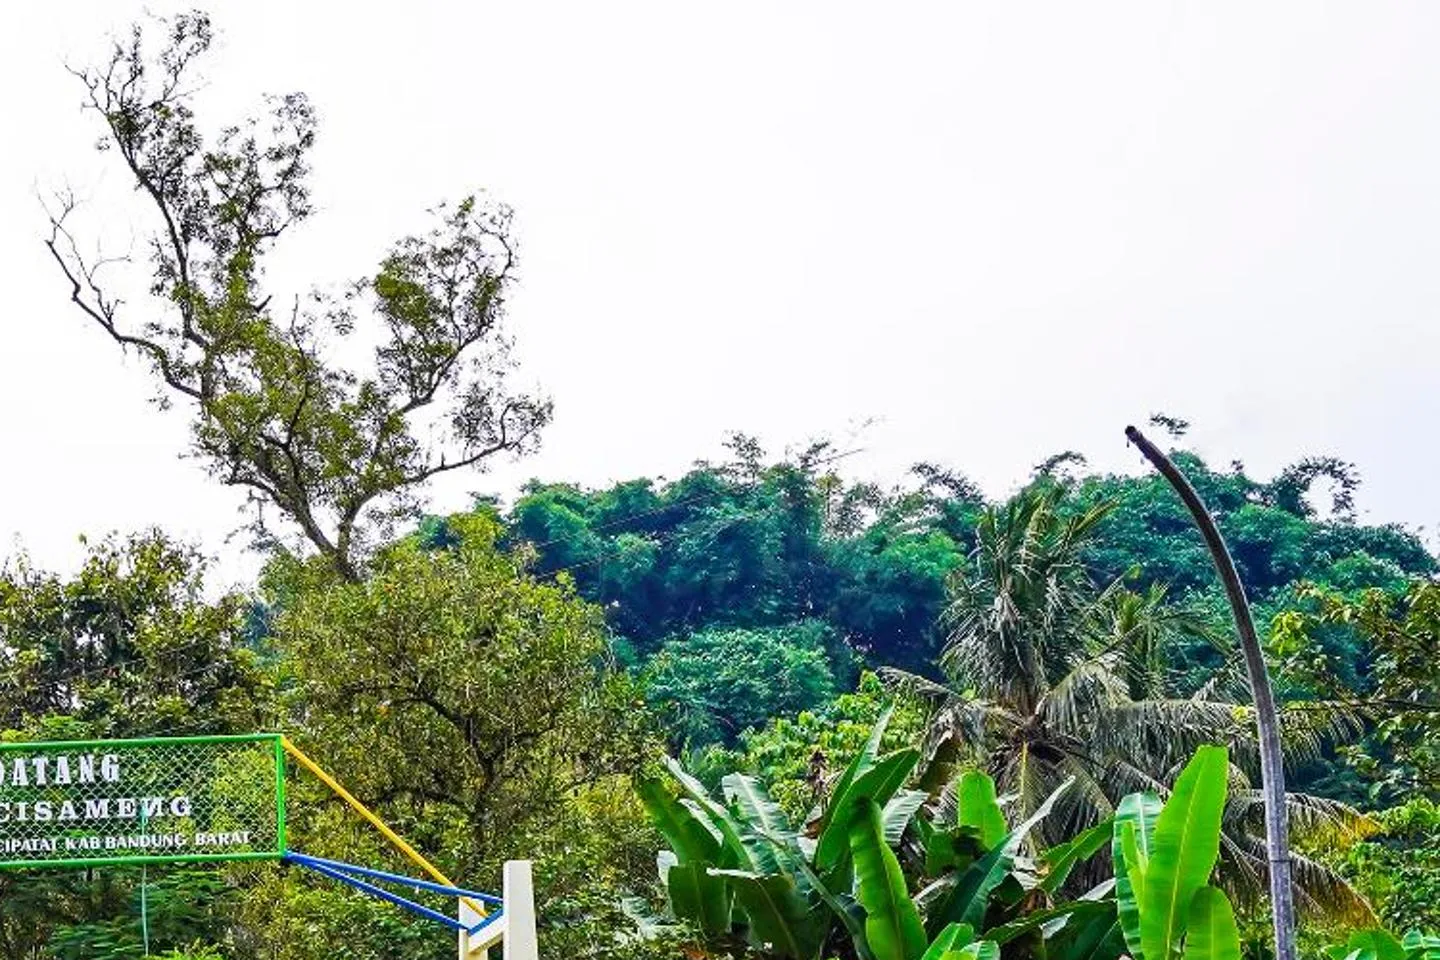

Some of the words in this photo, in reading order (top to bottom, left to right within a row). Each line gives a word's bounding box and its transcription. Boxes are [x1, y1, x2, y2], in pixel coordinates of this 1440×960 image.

[65, 835, 100, 851] KAB
[105, 833, 187, 850] BANDUNG
[195, 830, 251, 847] BARAT
